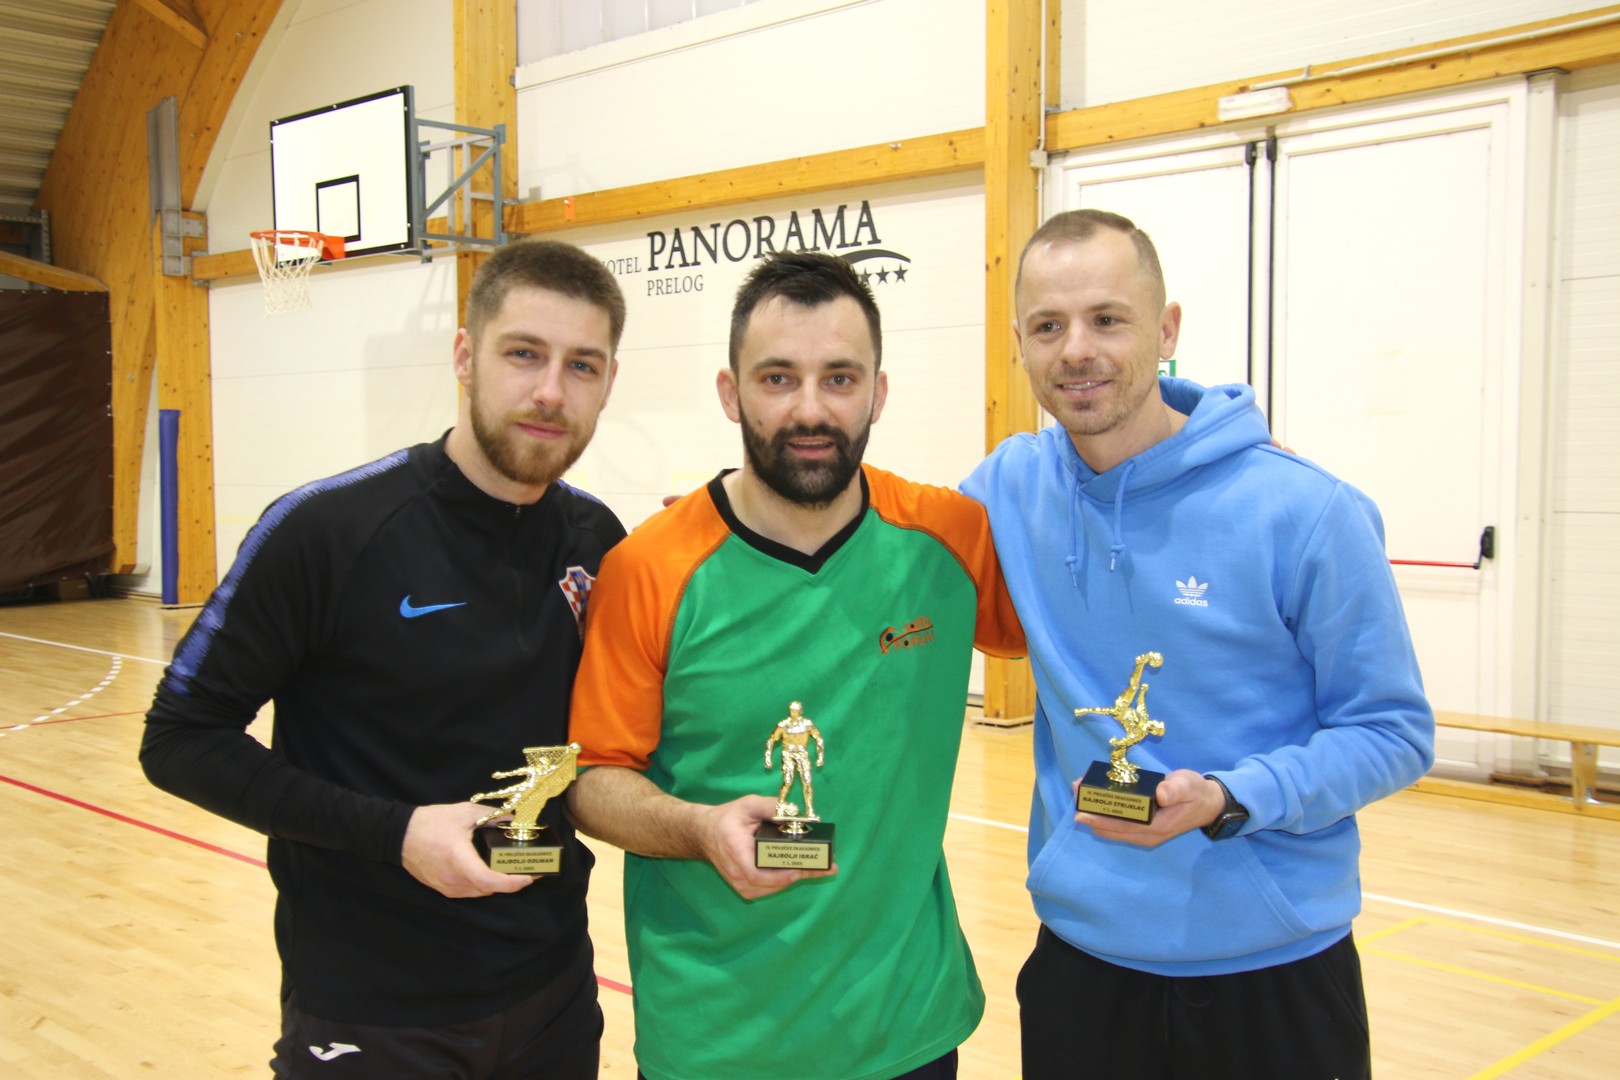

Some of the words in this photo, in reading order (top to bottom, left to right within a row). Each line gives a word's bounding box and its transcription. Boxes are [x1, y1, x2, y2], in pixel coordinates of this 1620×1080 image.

[602, 256, 642, 276] OTEL
[646, 200, 882, 272] PANORAMA
[646, 274, 704, 296] PRELOG
[1174, 597, 1209, 607] adidas
[1083, 797, 1112, 805] NAJBOLJI
